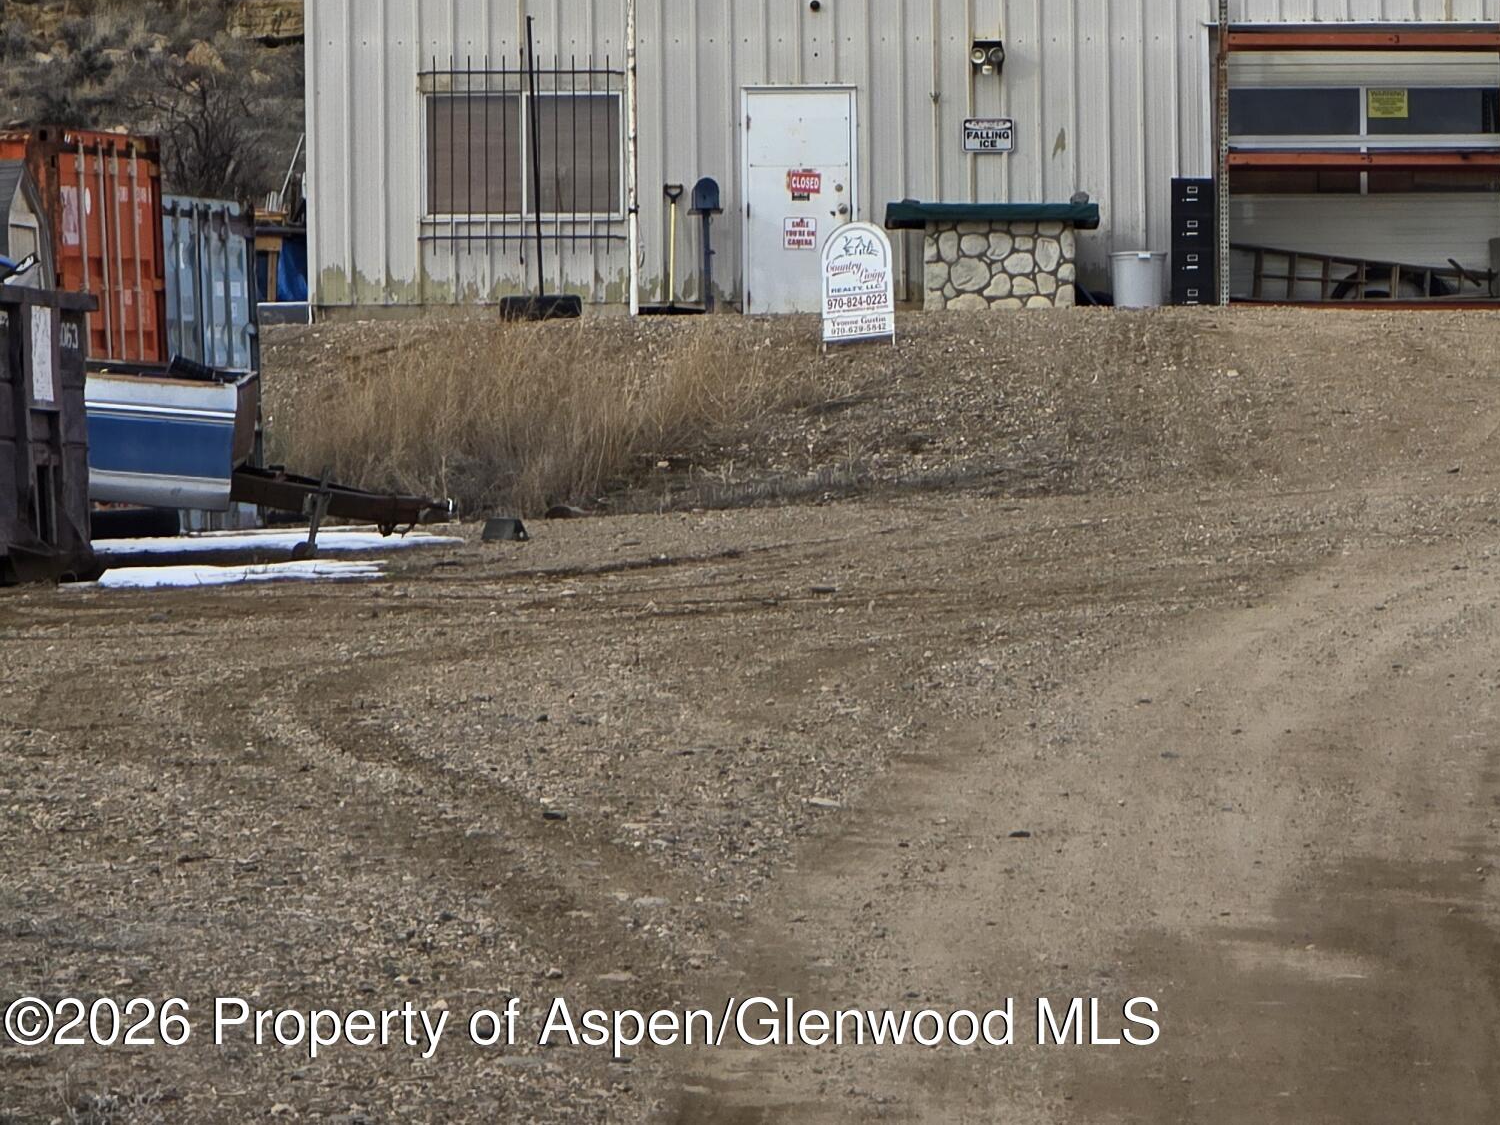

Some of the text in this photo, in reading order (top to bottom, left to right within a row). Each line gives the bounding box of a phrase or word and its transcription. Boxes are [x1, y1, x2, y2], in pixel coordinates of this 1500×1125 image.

[967, 131, 1009, 139] FALLING
[791, 176, 819, 189] CLOSED
[787, 238, 812, 246] CAMERA
[826, 261, 862, 275] Country
[860, 266, 886, 284] Living
[827, 294, 888, 310] 970-824-0223
